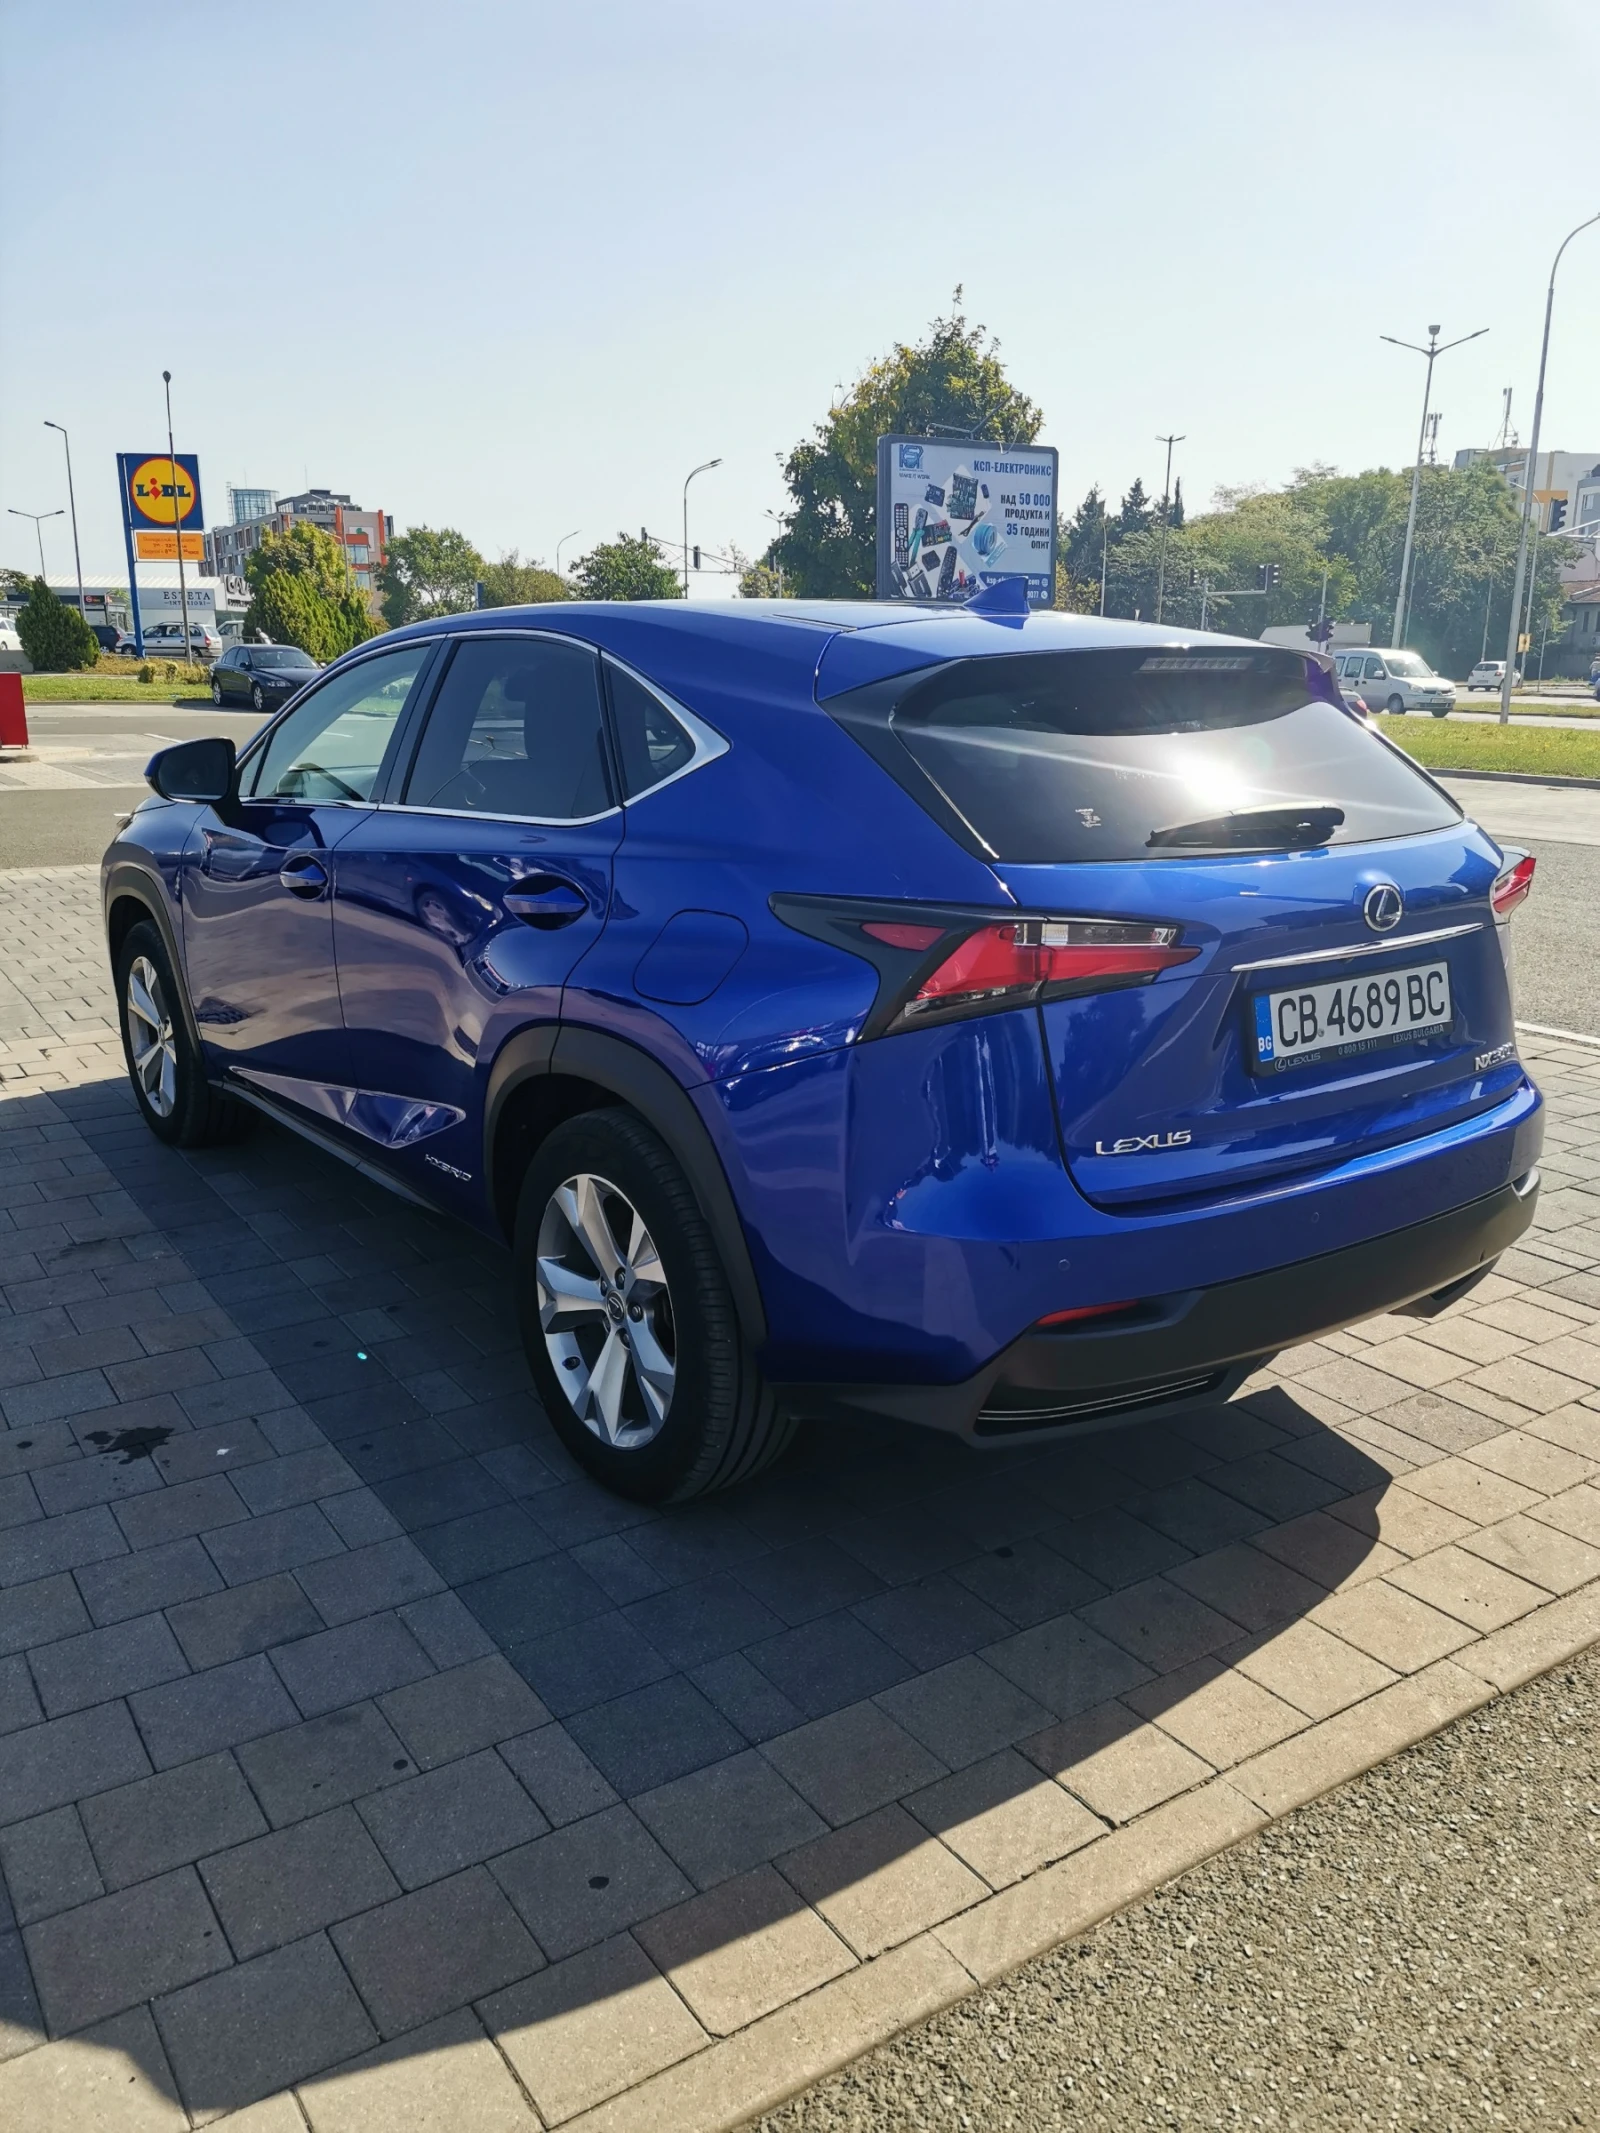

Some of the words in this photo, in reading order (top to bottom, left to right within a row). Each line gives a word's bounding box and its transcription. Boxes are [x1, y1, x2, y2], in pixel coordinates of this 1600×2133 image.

[974, 460, 1052, 476] КСП-ЕЛЕКТРОНИКС
[1001, 494, 1016, 506] НАД
[1019, 493, 1031, 505] 50
[1033, 493, 1051, 507] 000
[1005, 508, 1043, 520] ПРОДУКТА
[1045, 511, 1050, 520] И
[1006, 523, 1018, 535] 35
[1020, 526, 1050, 538] ГОДИНИ
[1031, 540, 1050, 550] ОПИТ
[163, 591, 211, 600] ESETA
[1392, 1031, 1413, 1044] LEXUS
[1413, 1024, 1445, 1039] BULGARIA
[1258, 1035, 1272, 1053] BG
[1287, 1052, 1321, 1067] LEXUS
[1095, 1129, 1192, 1155] LEXUS
[425, 1153, 472, 1182] HYBRID
